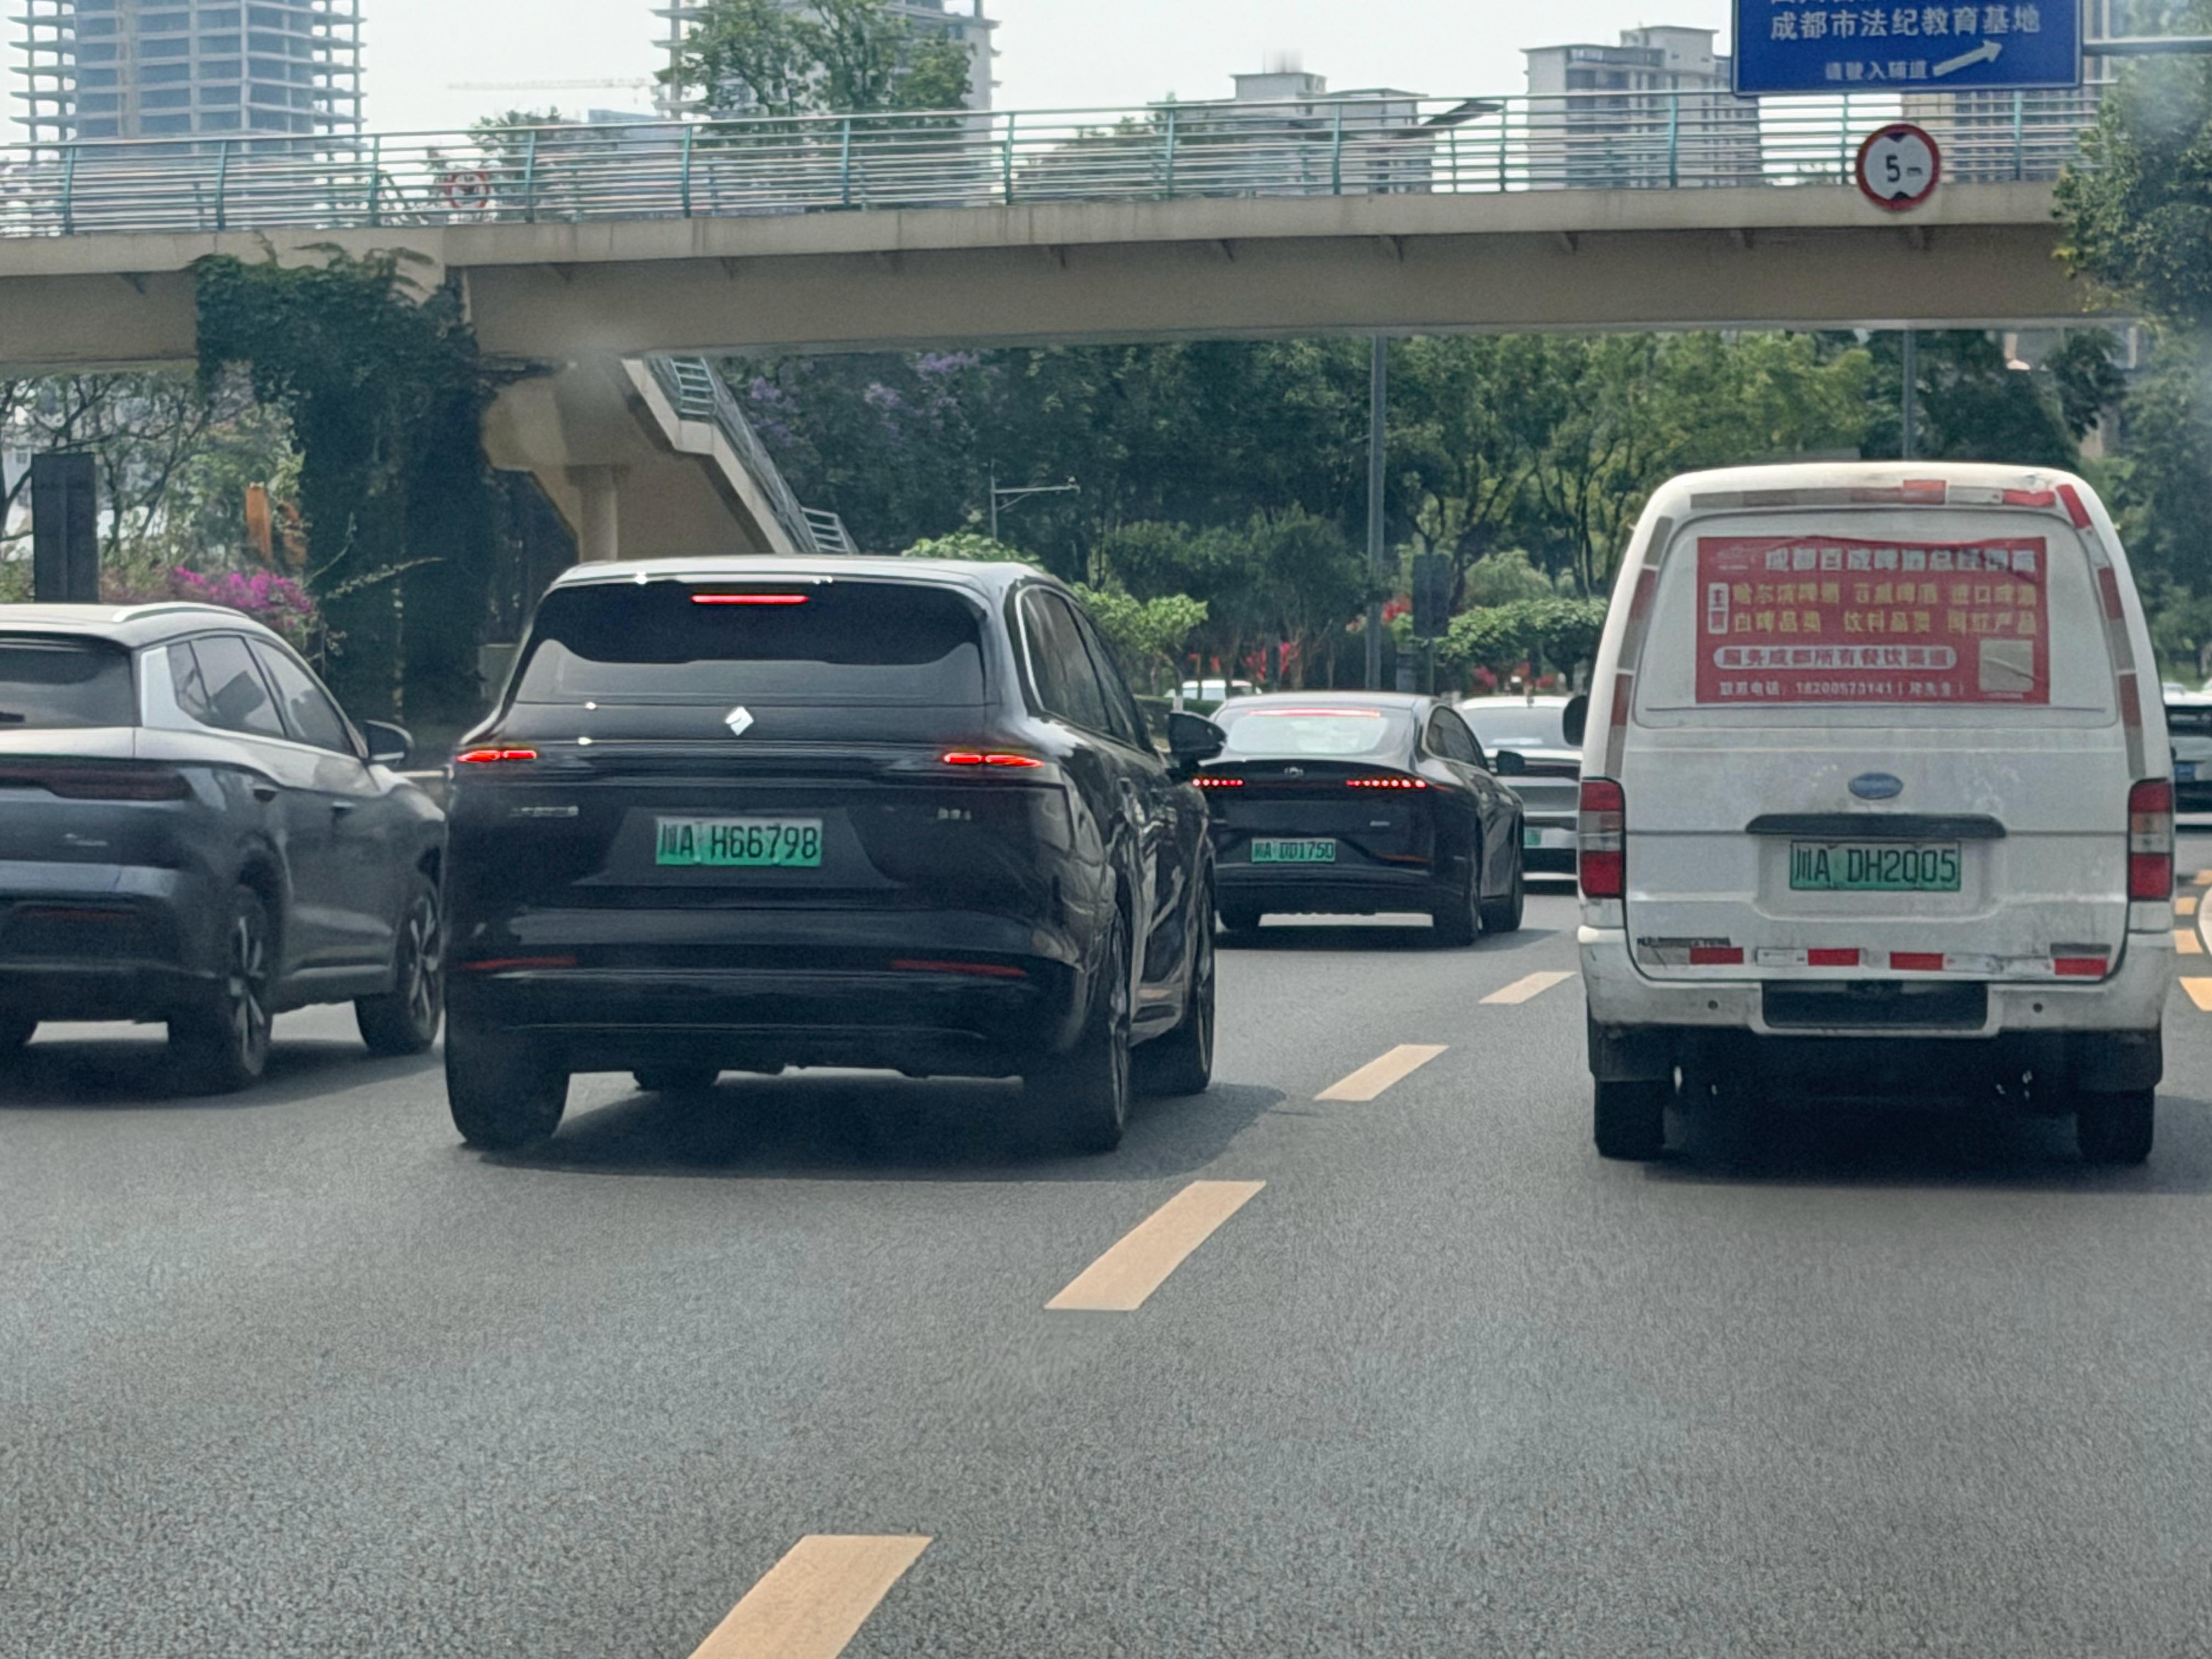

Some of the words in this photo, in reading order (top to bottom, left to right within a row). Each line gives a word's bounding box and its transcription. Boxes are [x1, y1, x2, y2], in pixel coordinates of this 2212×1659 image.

[1770, 5, 2040, 40] 成都市法纪教育基地
